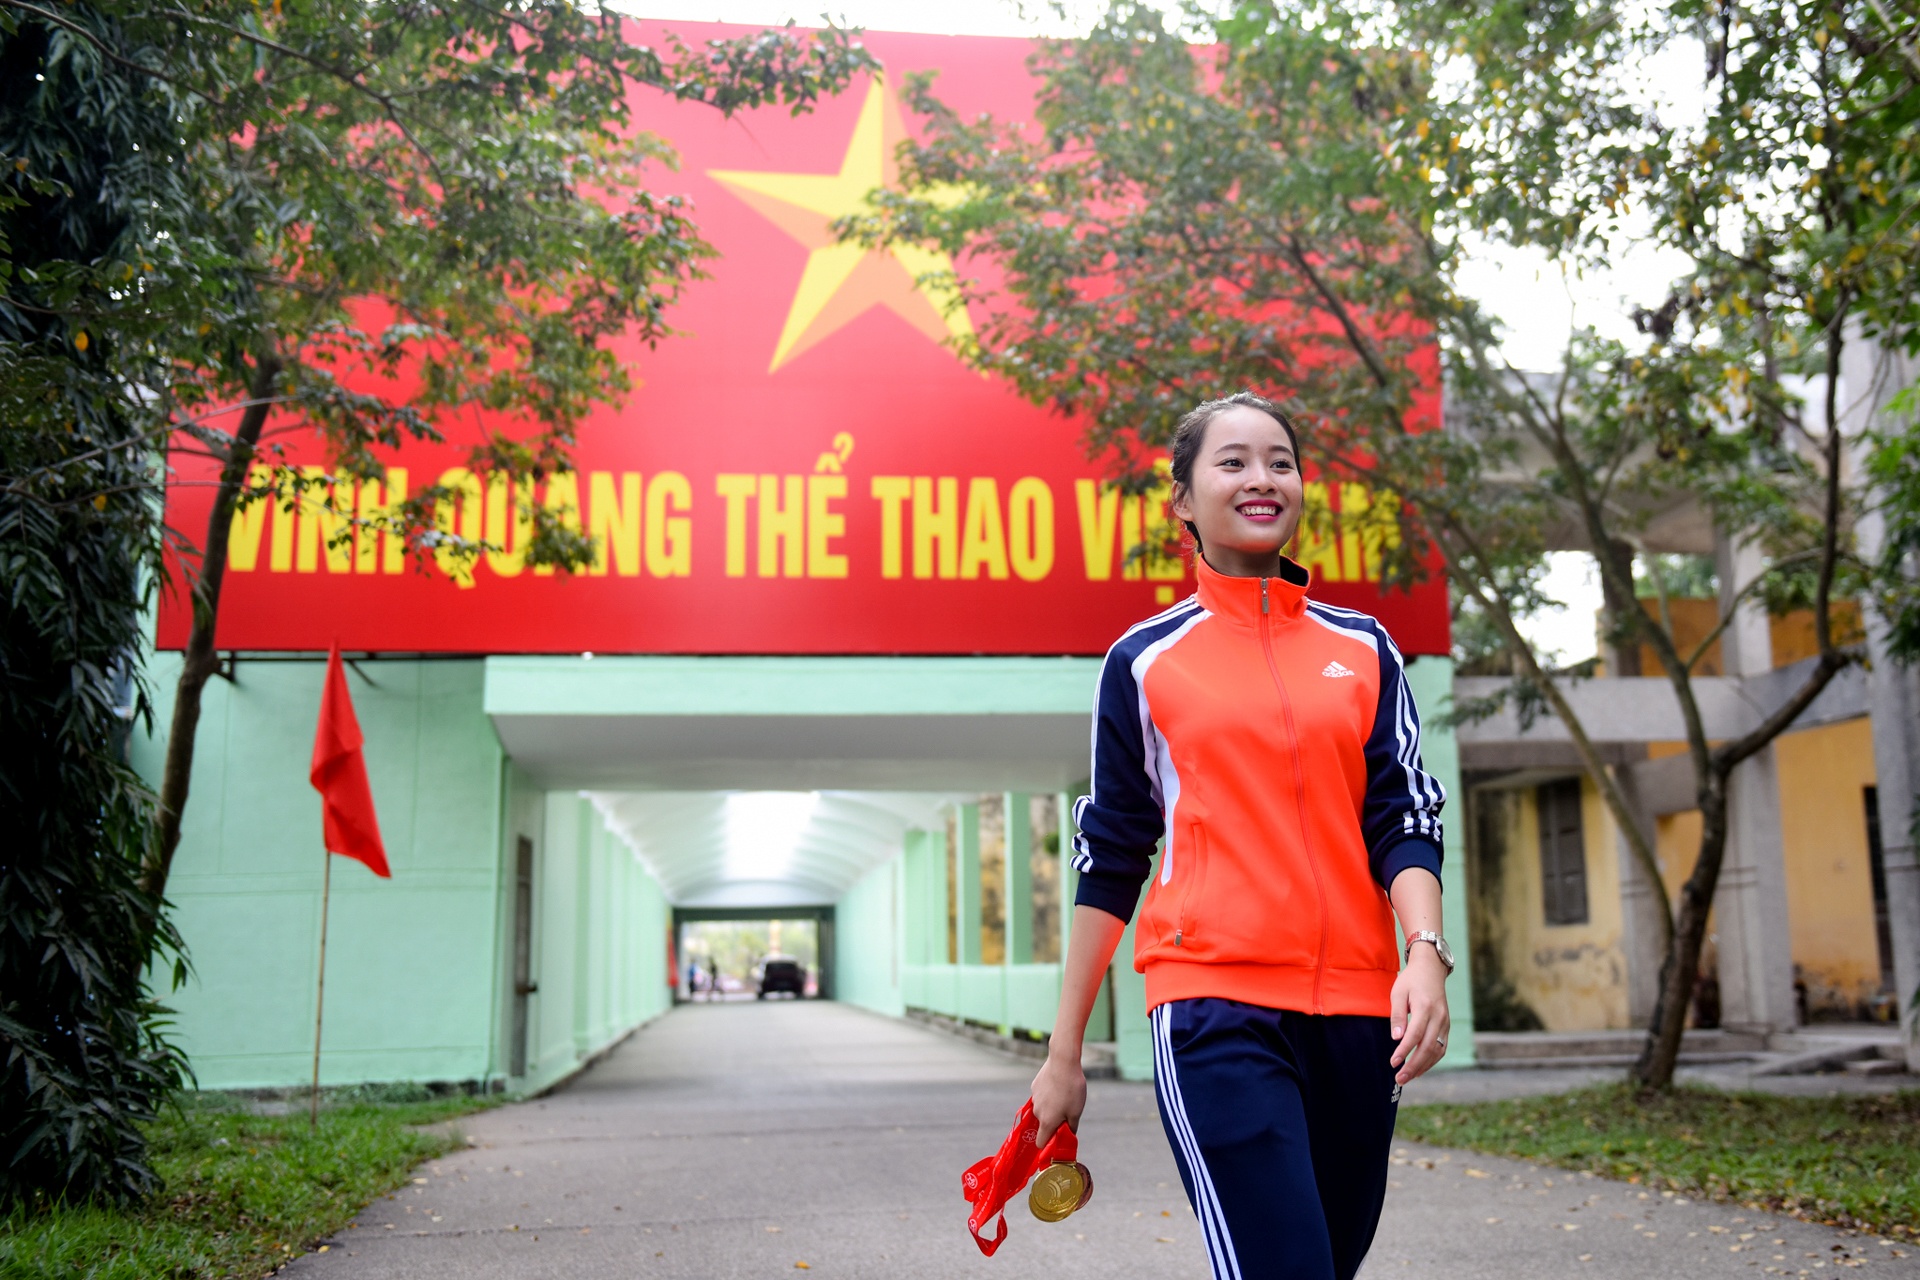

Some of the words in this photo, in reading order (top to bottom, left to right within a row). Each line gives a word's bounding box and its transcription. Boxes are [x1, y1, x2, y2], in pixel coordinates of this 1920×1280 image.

[227, 464, 409, 574] VINH
[434, 467, 692, 589] QUANG
[716, 432, 854, 578] THỂ
[871, 475, 1055, 582] THAO
[1075, 457, 1199, 604] VIỆ
[1280, 481, 1401, 583] AM
[1321, 669, 1355, 678] adidas
